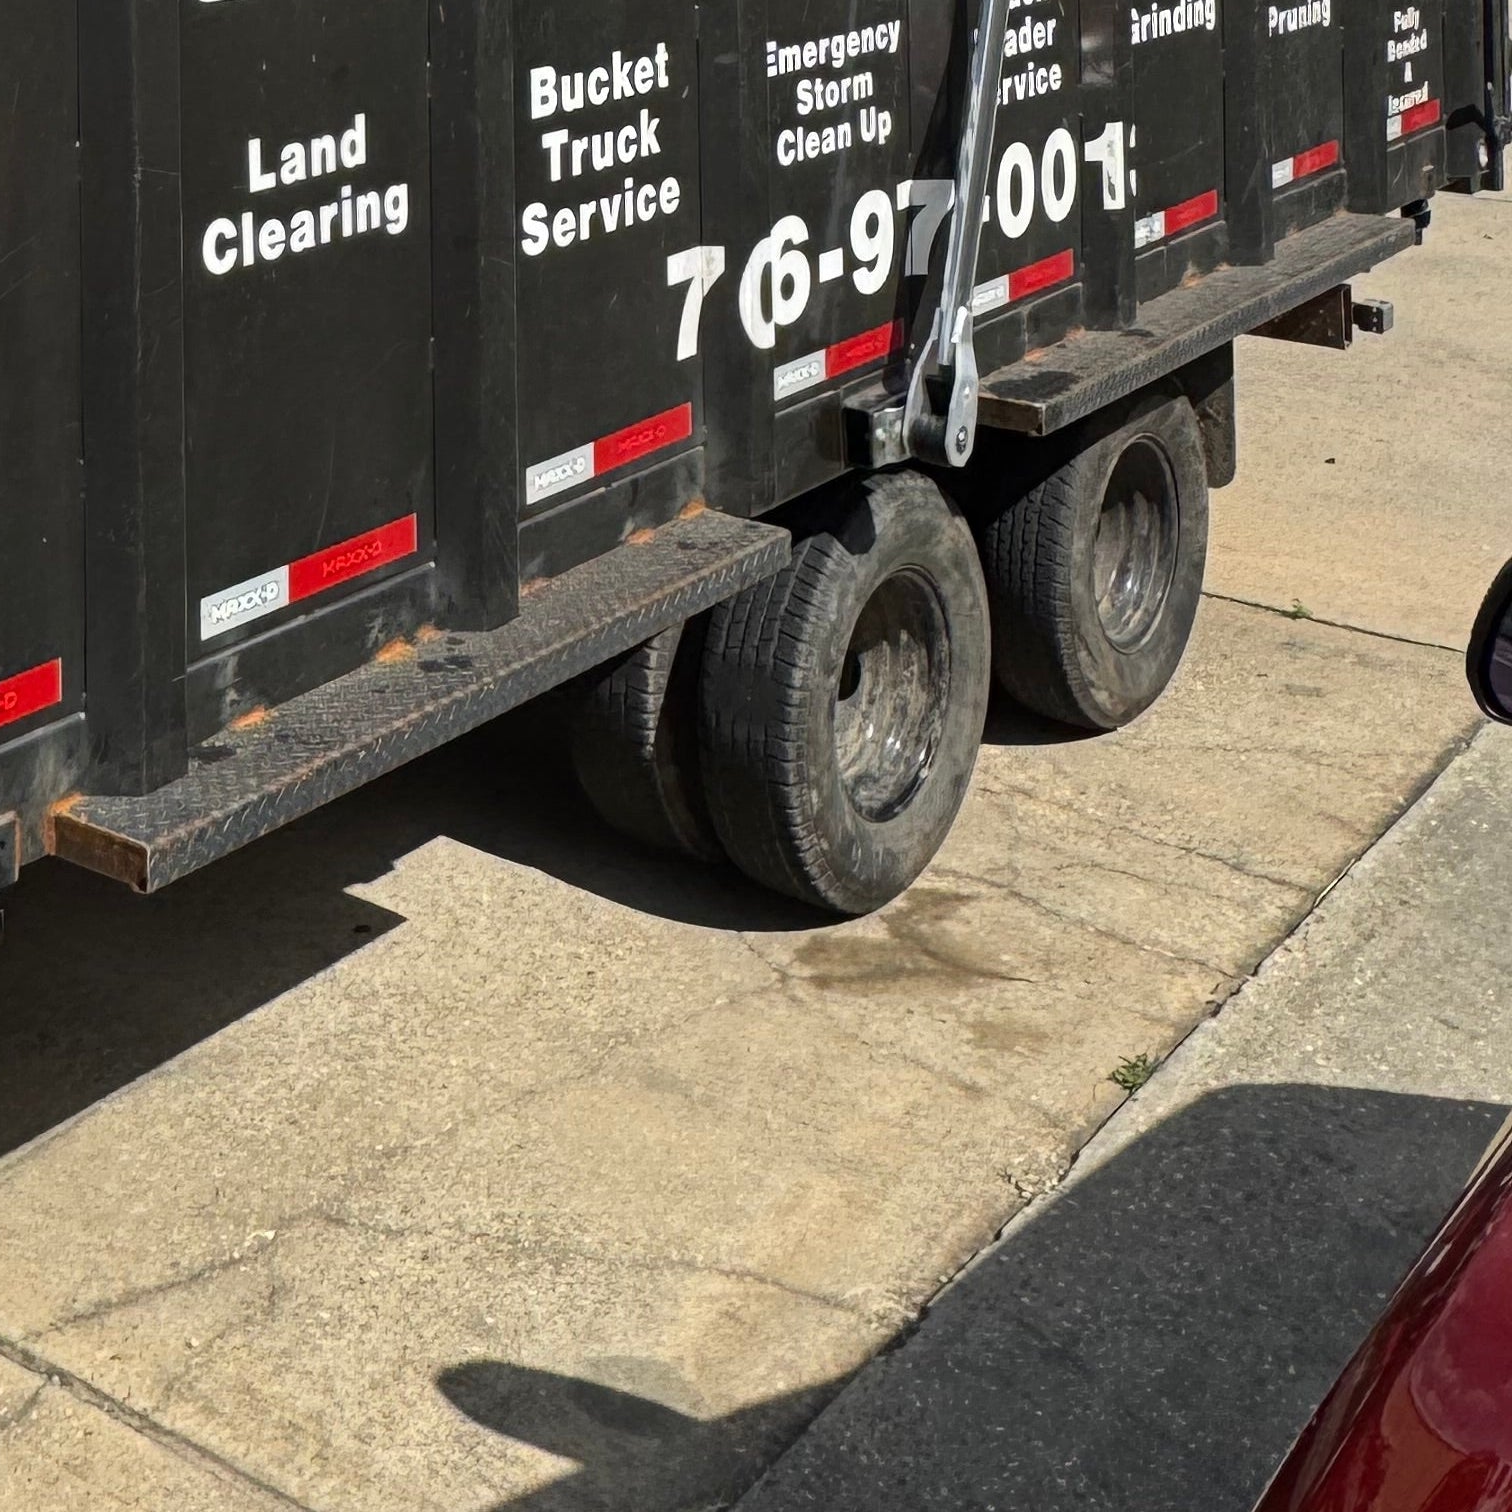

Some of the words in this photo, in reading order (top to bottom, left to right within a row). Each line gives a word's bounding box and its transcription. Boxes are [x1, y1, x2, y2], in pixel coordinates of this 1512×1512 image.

[974, 16, 1057, 57] ader
[530, 42, 669, 120] Bucket
[796, 71, 874, 116] Storm
[996, 61, 1063, 106] rvice
[248, 113, 366, 193] Land
[541, 109, 662, 182] Truck
[777, 120, 852, 166] Clean
[860, 106, 892, 145] Up
[202, 182, 409, 276] Clearing
[522, 176, 681, 256] Service
[209, 580, 280, 625] MAXX-D
